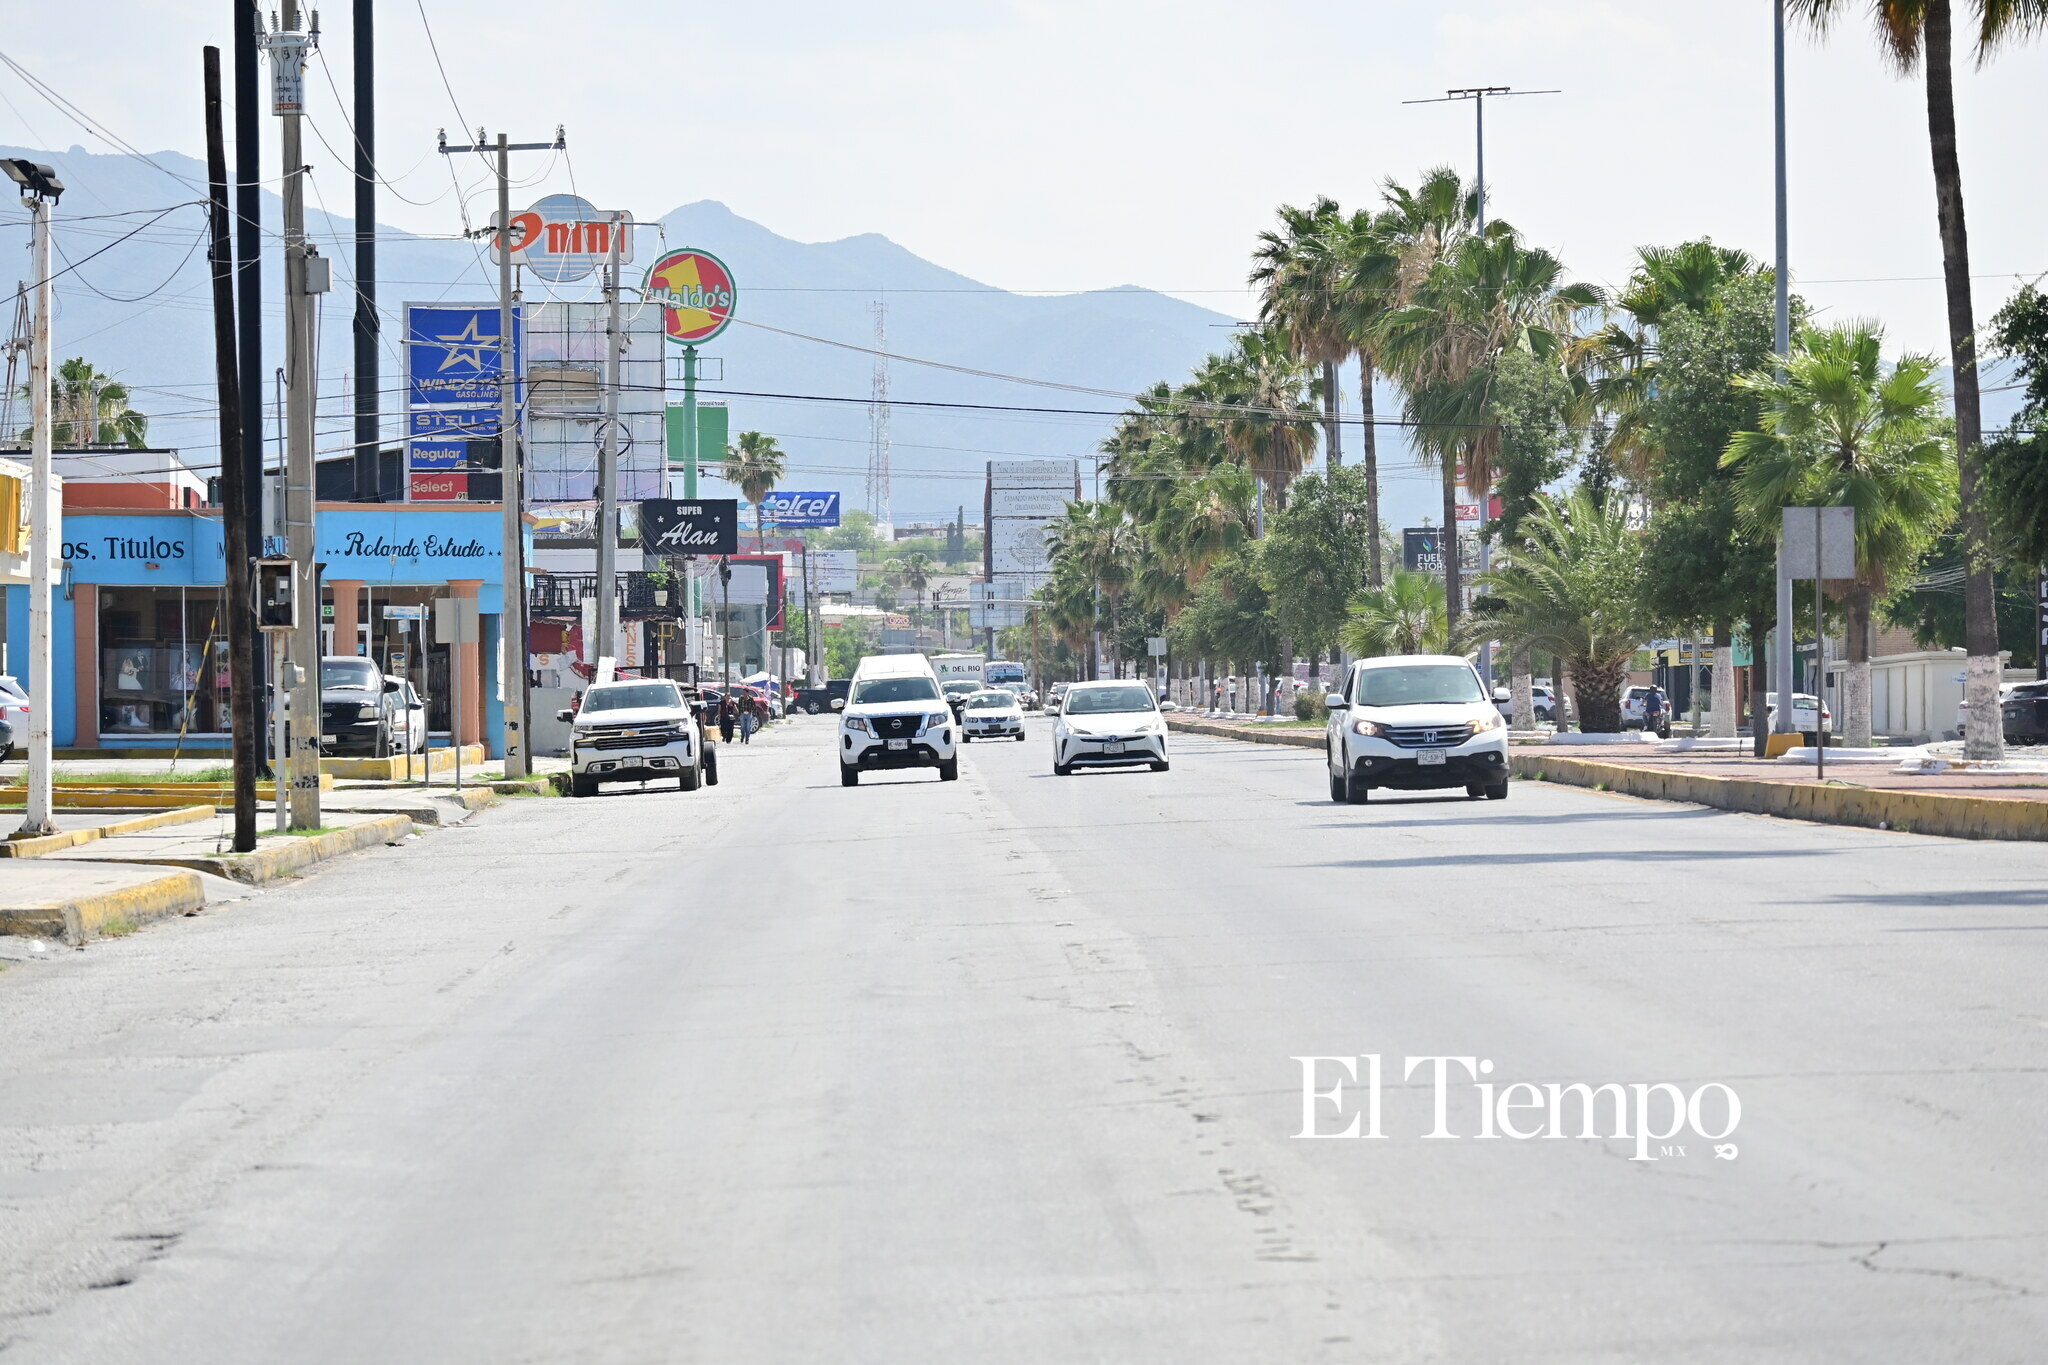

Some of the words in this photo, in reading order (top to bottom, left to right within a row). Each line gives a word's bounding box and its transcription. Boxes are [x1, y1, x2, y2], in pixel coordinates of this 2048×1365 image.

[495, 212, 625, 253] Omni
[648, 284, 731, 309] Waldo's
[419, 378, 502, 391] WINDSTA
[413, 447, 461, 461] Regular
[412, 481, 453, 493] Select
[676, 506, 703, 516] SUPER
[763, 494, 836, 517] telcel
[656, 521, 719, 546] Alan
[104, 535, 185, 559] Titulos
[344, 531, 420, 557] Rolando
[423, 534, 485, 558] Estudio
[1417, 553, 1441, 562] FUEL
[952, 665, 967, 673] DEL
